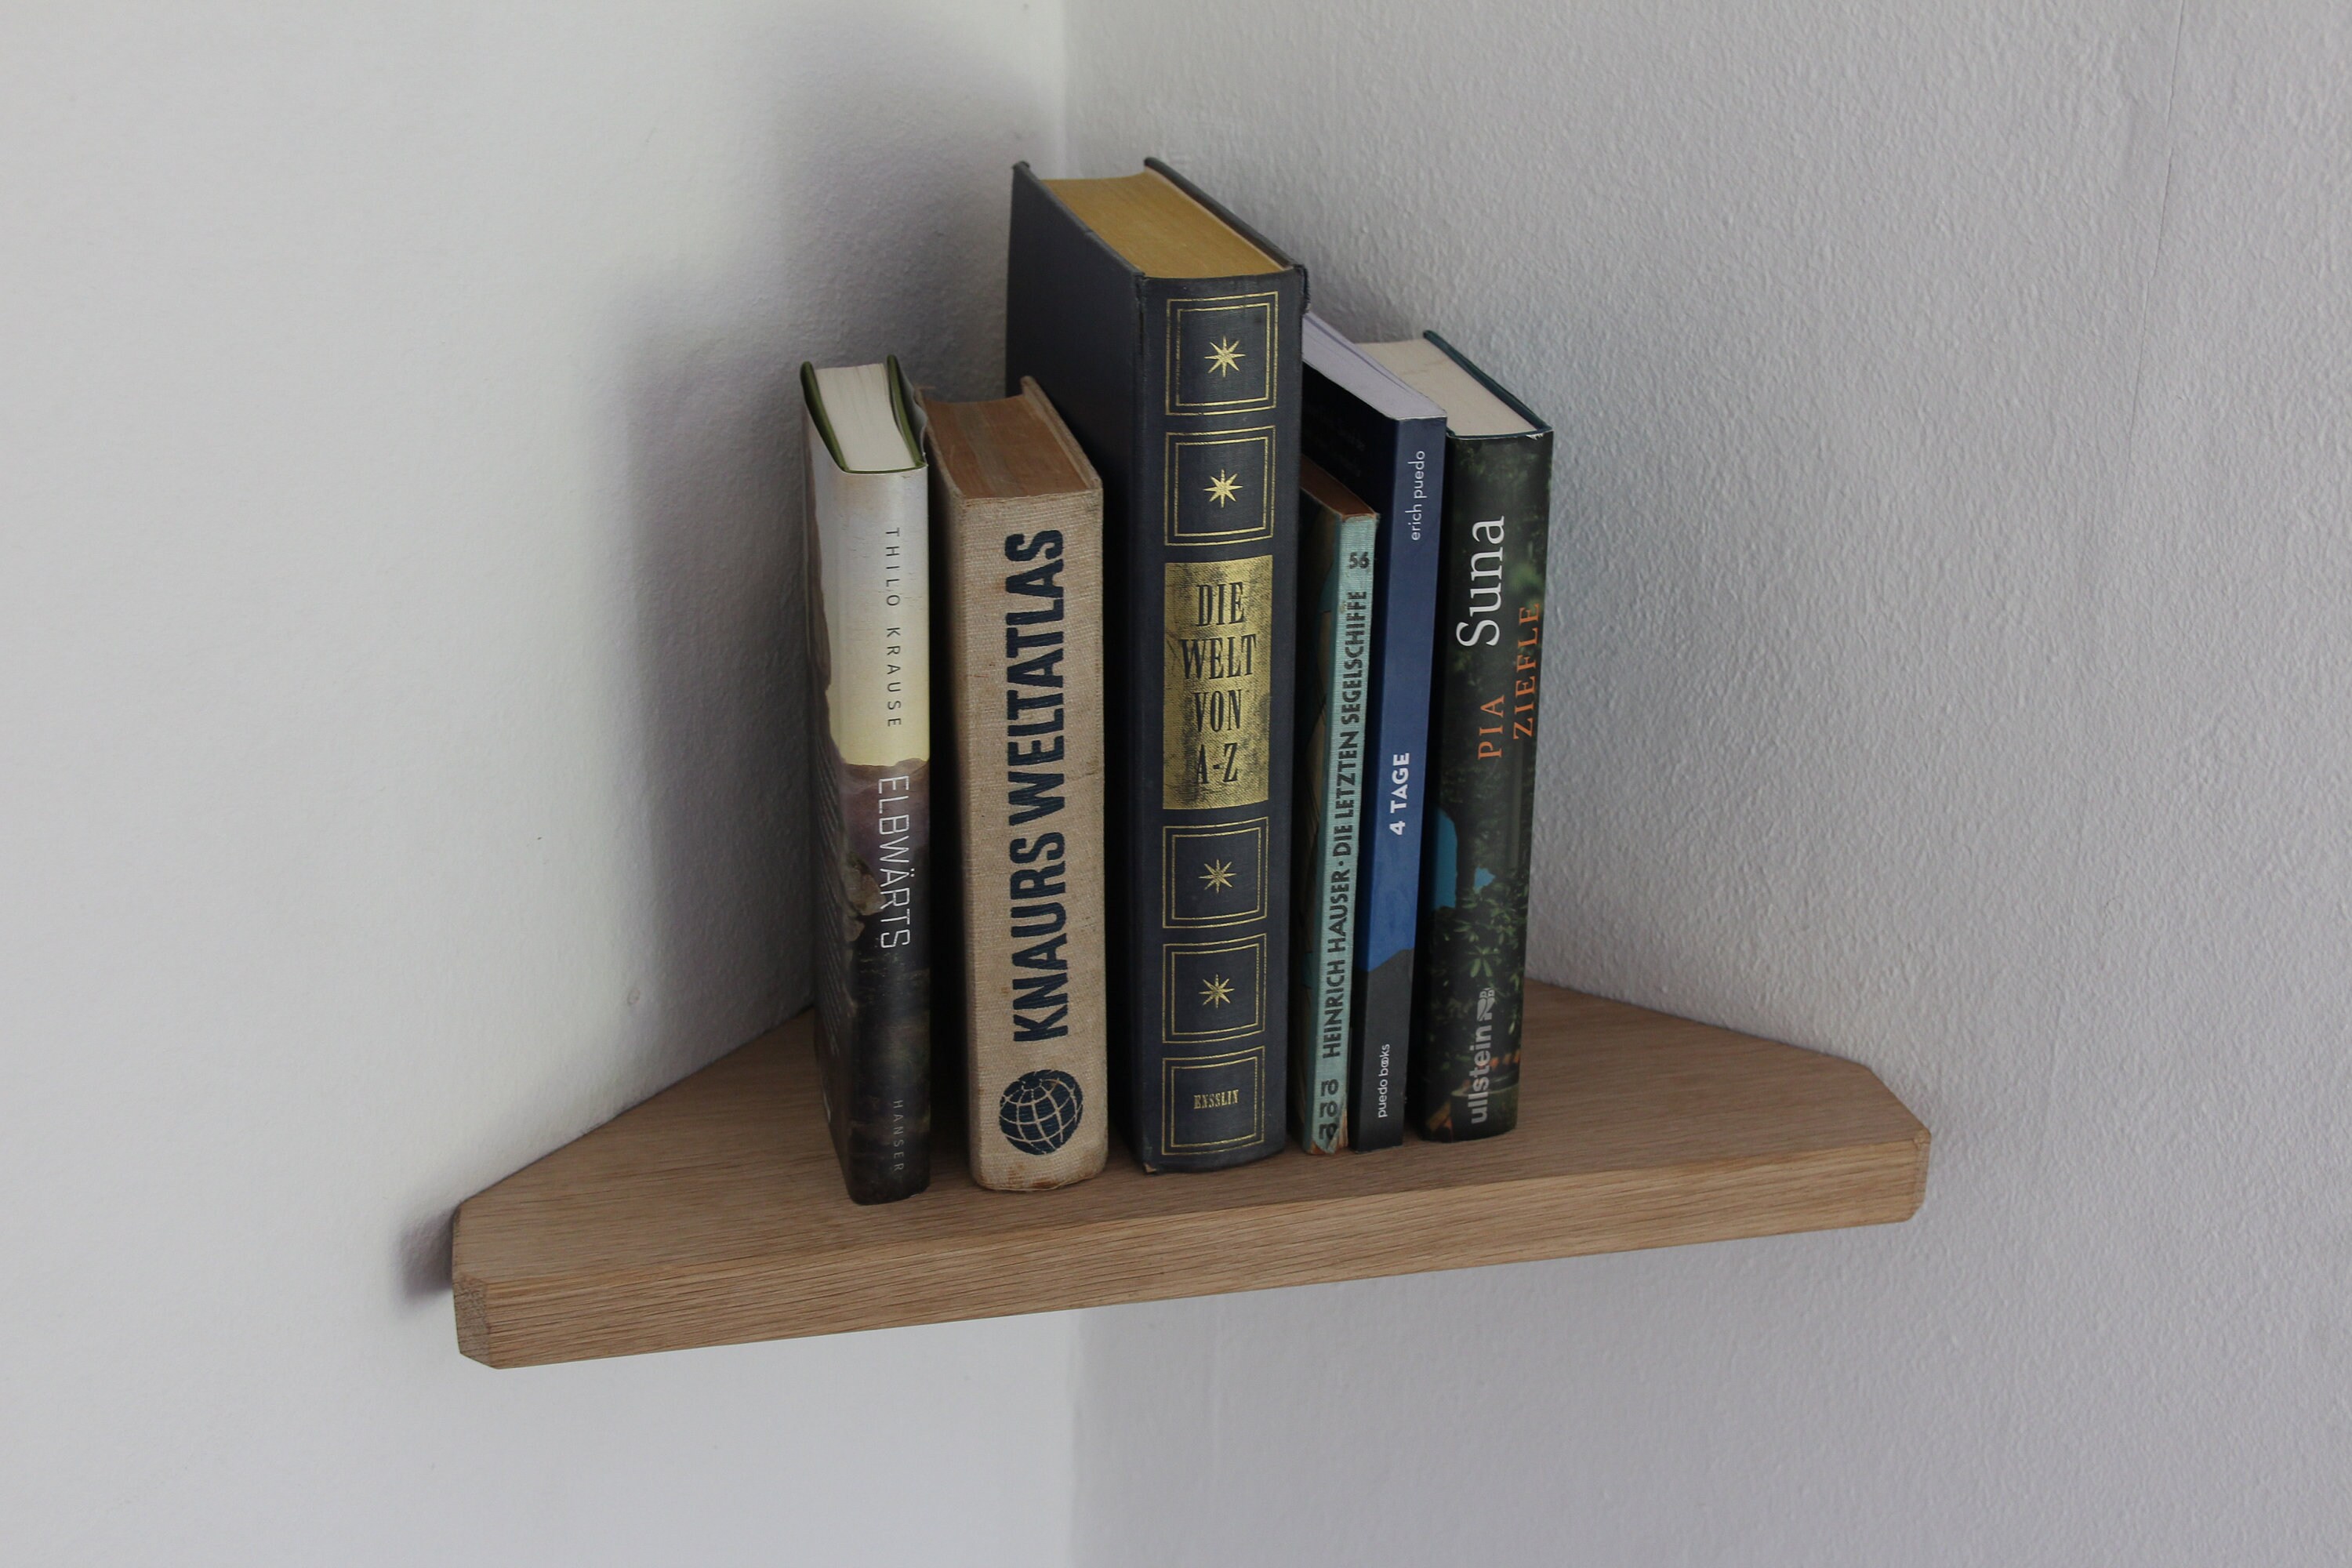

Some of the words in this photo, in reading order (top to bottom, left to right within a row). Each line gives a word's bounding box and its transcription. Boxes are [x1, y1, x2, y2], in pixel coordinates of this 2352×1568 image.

[1407, 450, 1427, 499] puedo
[1405, 503, 1421, 541] erich
[885, 527, 900, 607] THILO
[1348, 552, 1370, 569] 56
[1456, 515, 1504, 647] Suna
[1196, 582, 1245, 627] DIE
[886, 627, 902, 728] KRAUSE
[1004, 529, 1065, 826] WELTATLAS
[1179, 633, 1256, 680] WELT
[1341, 591, 1367, 725] SEGELSCHIFFE
[1513, 603, 1540, 739] ZIEFLE
[1192, 689, 1242, 732] VON
[1477, 695, 1504, 760] PIA
[1334, 731, 1359, 818] LETZTEN
[1390, 753, 1410, 814] TAGE
[878, 775, 915, 949] ELBWÄRTS
[1333, 824, 1352, 857] DIE
[1389, 821, 1405, 836] 4
[1009, 832, 1069, 1043] KNAURS
[1323, 959, 1345, 1058] HEINRICH
[1378, 1044, 1390, 1077] books
[1468, 1025, 1492, 1124] ullstein
[1377, 1079, 1388, 1119] puedo
[893, 1099, 905, 1173] HANSER
